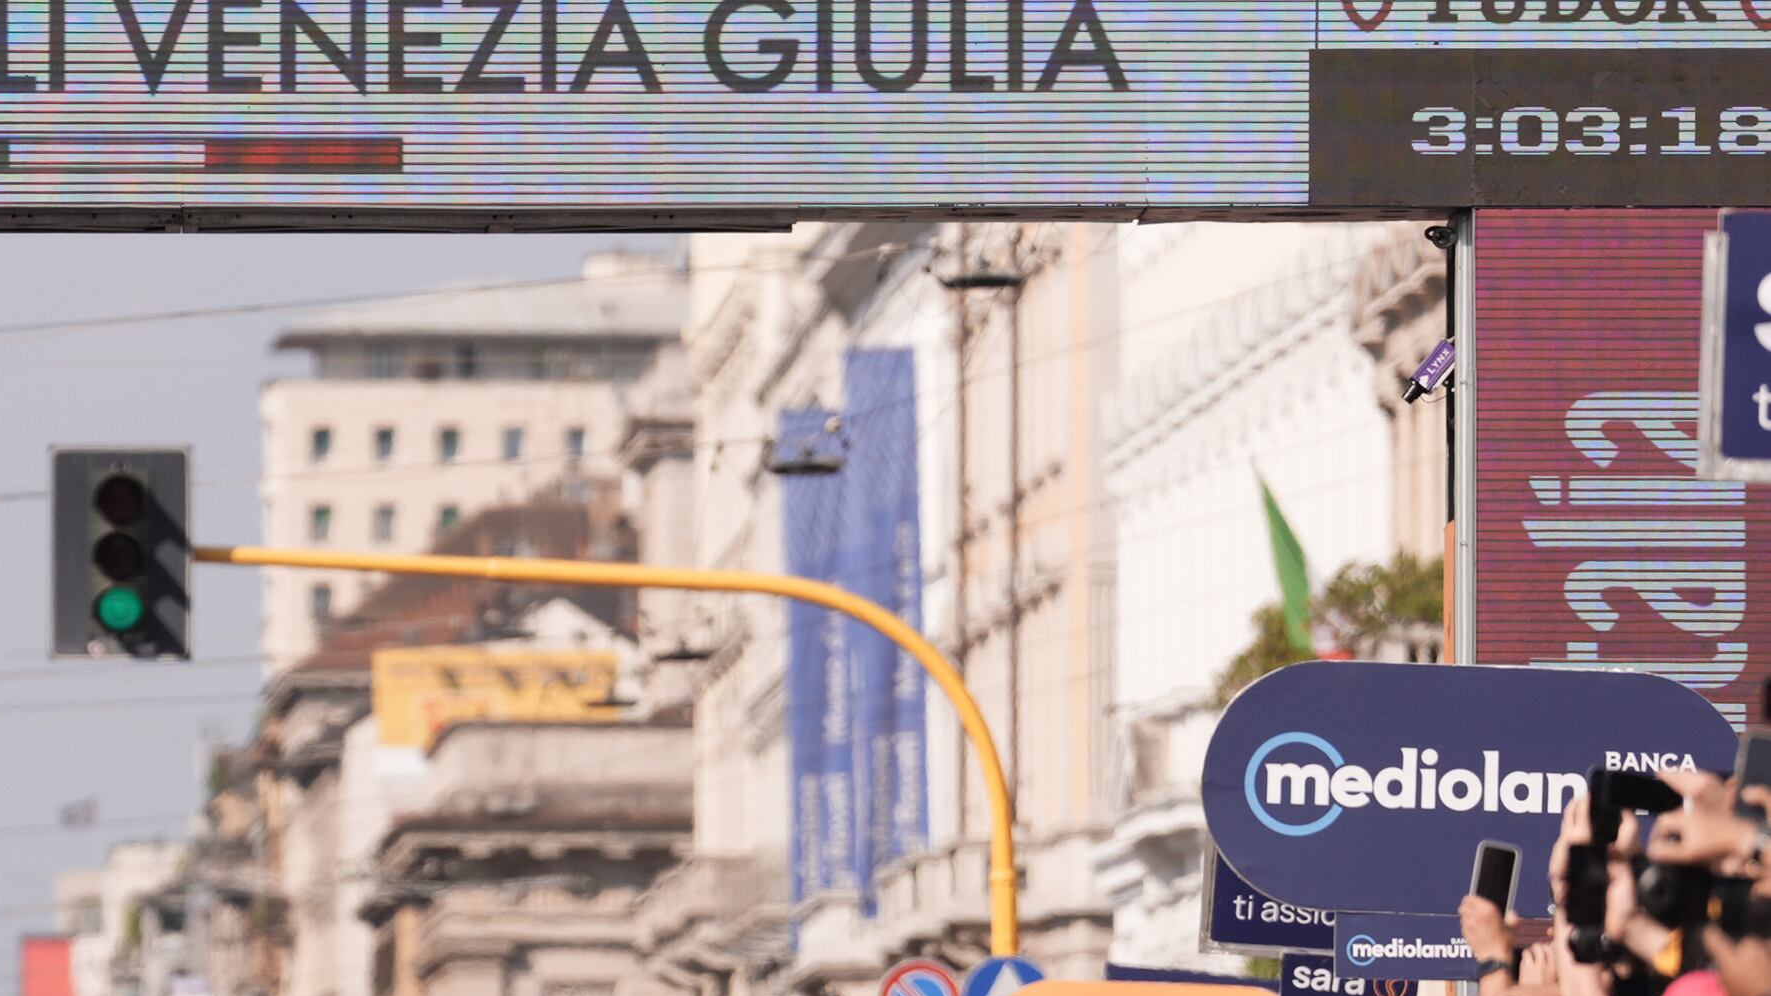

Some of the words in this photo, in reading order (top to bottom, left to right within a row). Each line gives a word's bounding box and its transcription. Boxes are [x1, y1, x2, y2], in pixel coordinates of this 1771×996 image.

[119, 0, 662, 95] VENEZIA
[703, 0, 1128, 93] GIULIA
[1411, 106, 1771, 156] 3:03:18
[1426, 348, 1450, 375] LYNX
[1265, 748, 1592, 814] mediolan
[1605, 751, 1698, 775] BANCA
[1233, 895, 1254, 920] ti
[1260, 901, 1335, 926] assic
